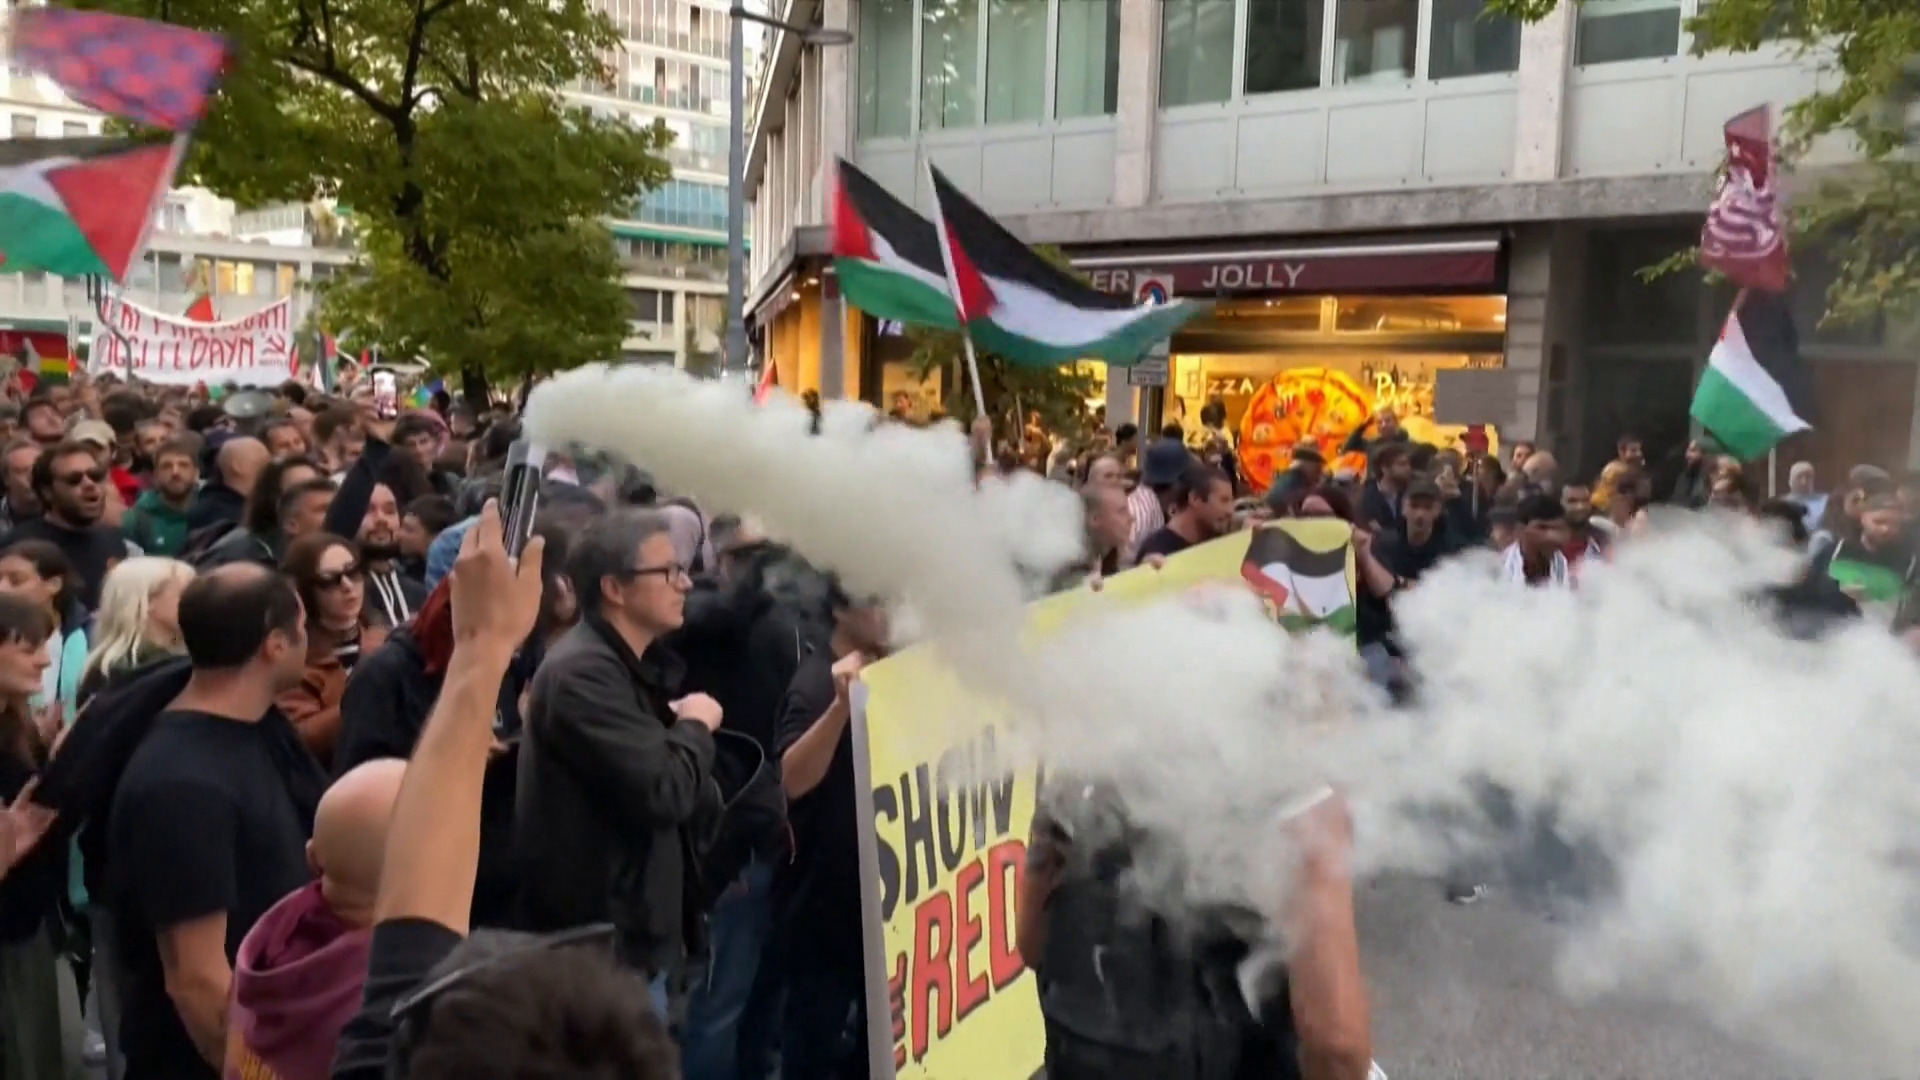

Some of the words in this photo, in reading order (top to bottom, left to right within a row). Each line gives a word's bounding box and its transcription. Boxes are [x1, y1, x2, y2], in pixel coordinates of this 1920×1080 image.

[1202, 264, 1306, 289] JOLLY
[872, 725, 1014, 922] SHOW
[911, 840, 1027, 1064] RED
